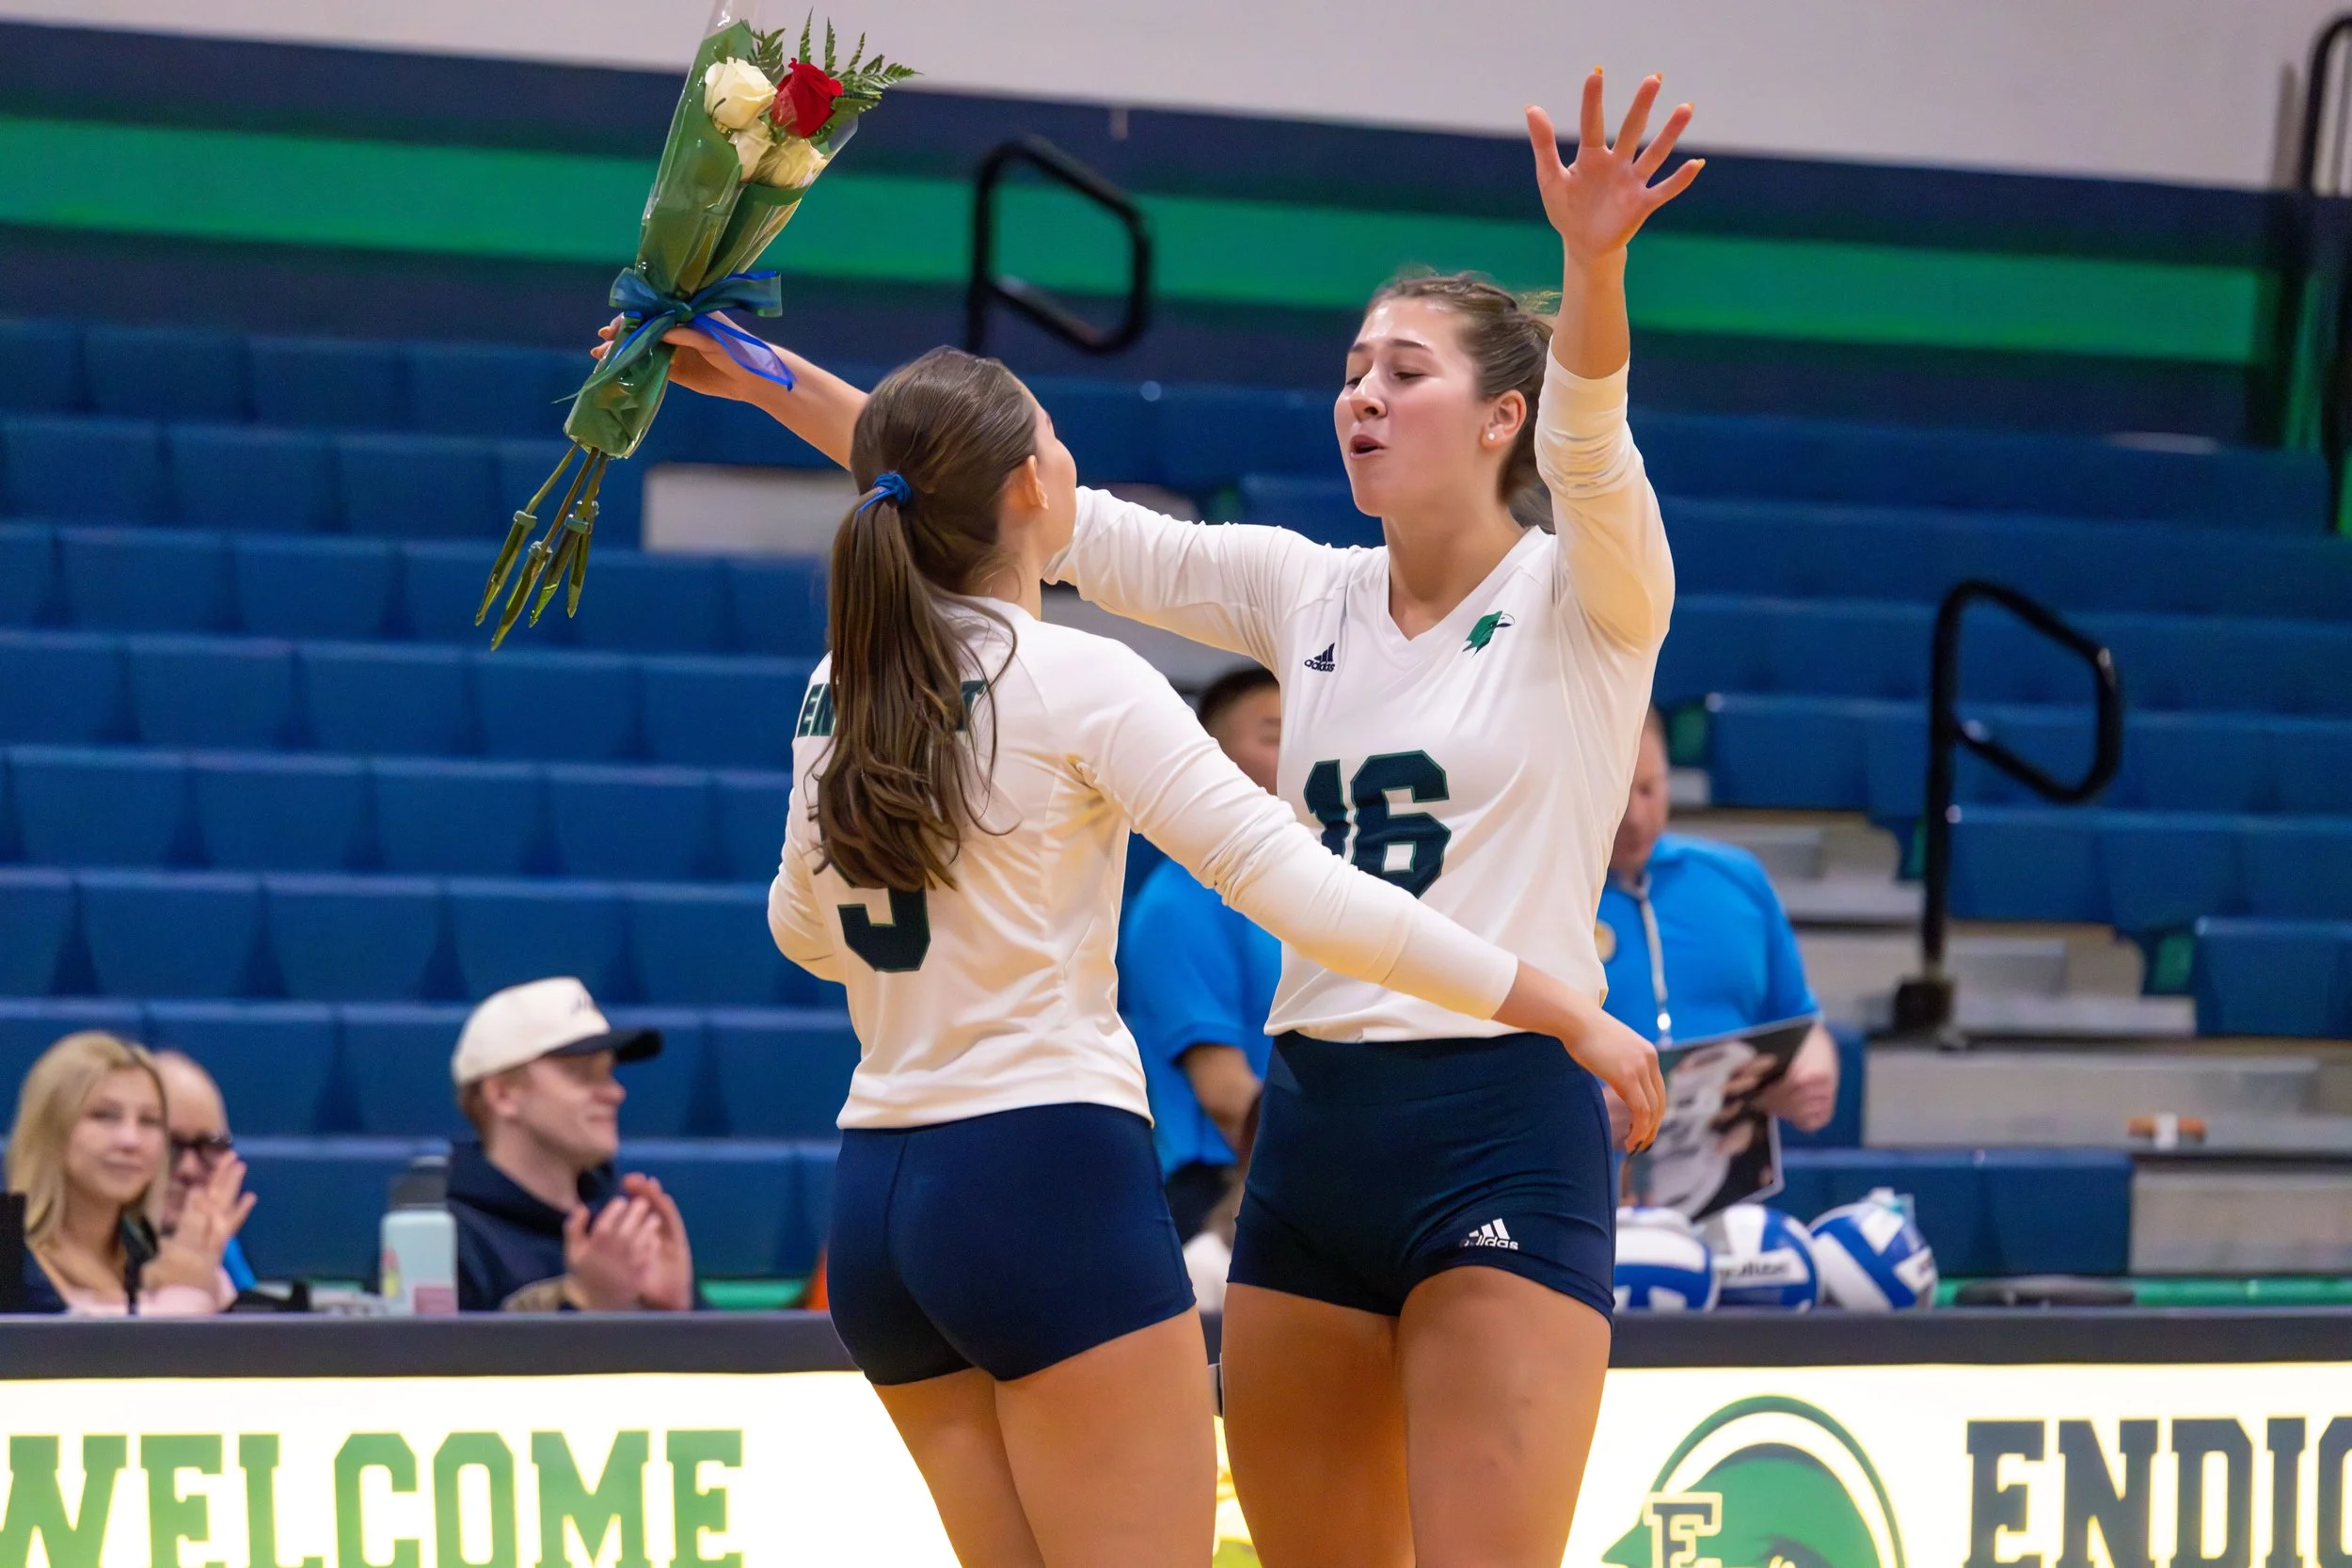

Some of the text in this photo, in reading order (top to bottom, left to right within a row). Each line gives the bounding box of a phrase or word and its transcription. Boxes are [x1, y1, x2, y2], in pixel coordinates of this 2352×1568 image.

[1304, 658, 1336, 673] adidas
[1303, 750, 1453, 900] 16
[0, 1430, 743, 1568] WELCOME
